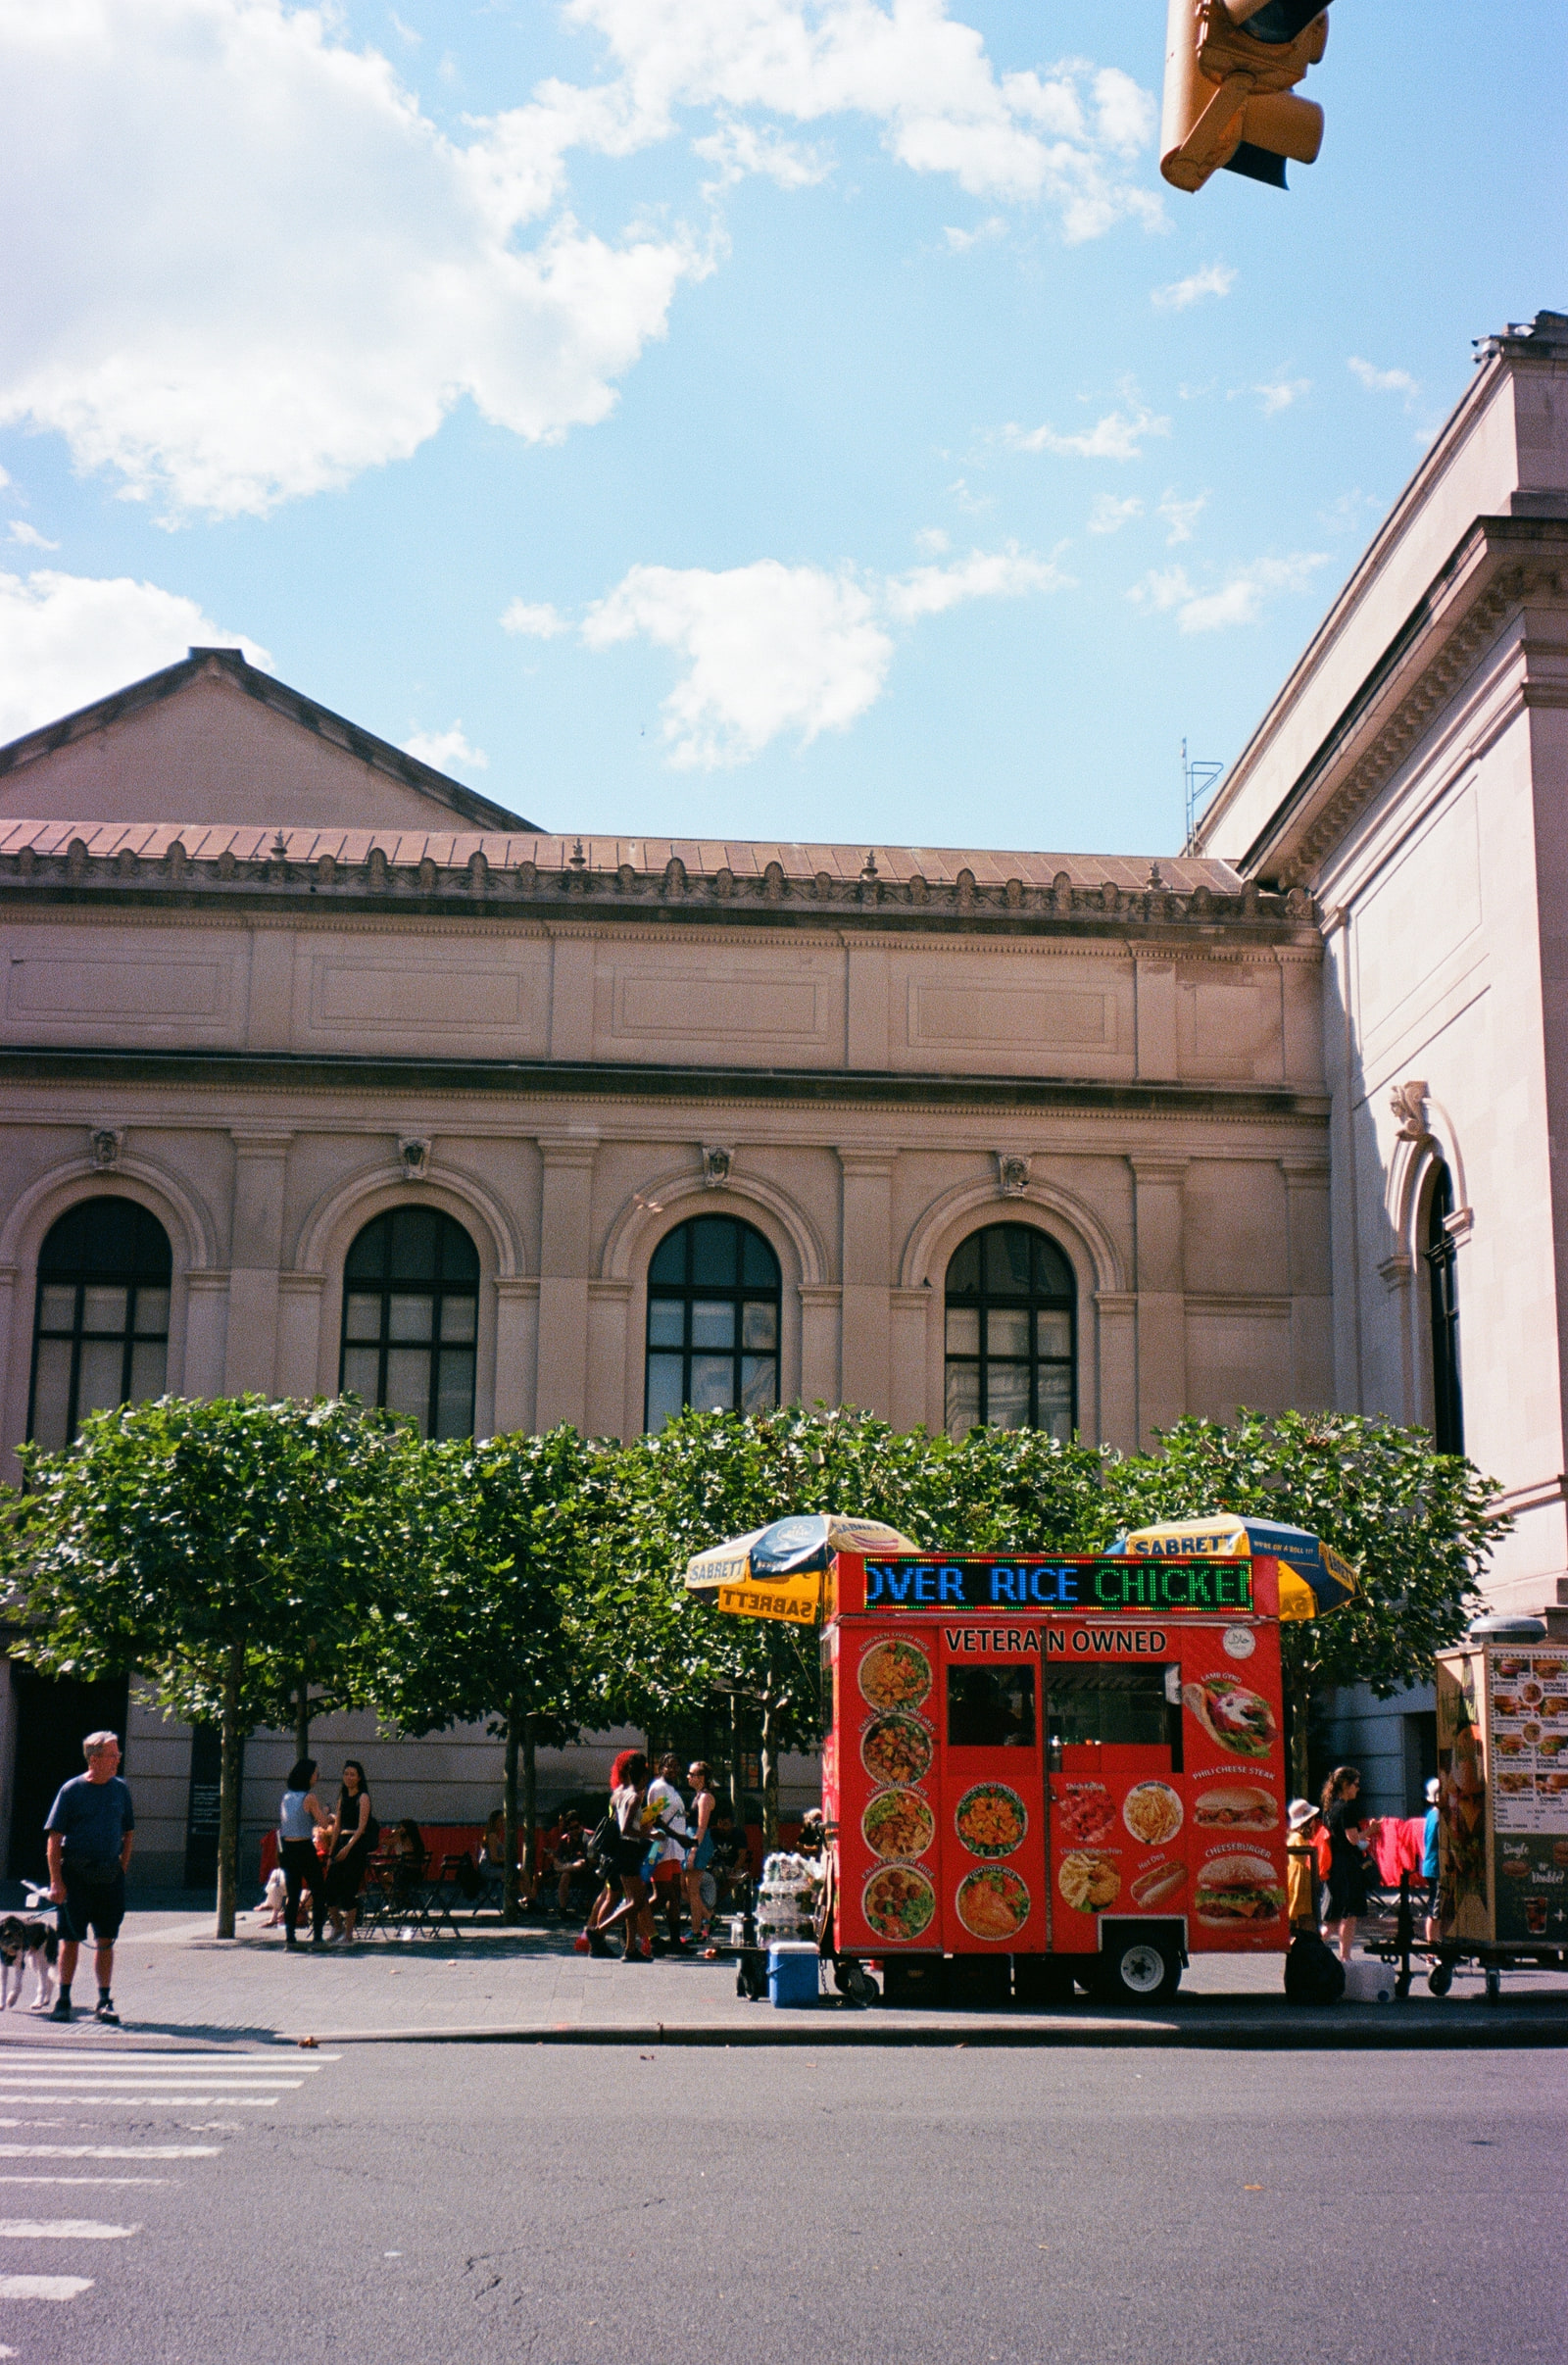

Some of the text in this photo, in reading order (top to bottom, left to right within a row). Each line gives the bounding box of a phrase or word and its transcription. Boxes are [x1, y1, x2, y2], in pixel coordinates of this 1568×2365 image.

[689, 1558, 744, 1582] SABRETT
[991, 1566, 1079, 1602] RICE
[858, 1631, 889, 1652] CHICKEN
[891, 1631, 913, 1640] OVER
[945, 1628, 1168, 1654] VETERAN OWNED
[1200, 1672, 1242, 1684] LAMB GYRO
[1193, 1765, 1276, 1780] PHILI CHEESE STEAK
[1205, 1843, 1272, 1858] CHEESEBURGER
[1503, 1842, 1530, 1859] Single
[1137, 1852, 1165, 1870] Hot Dog
